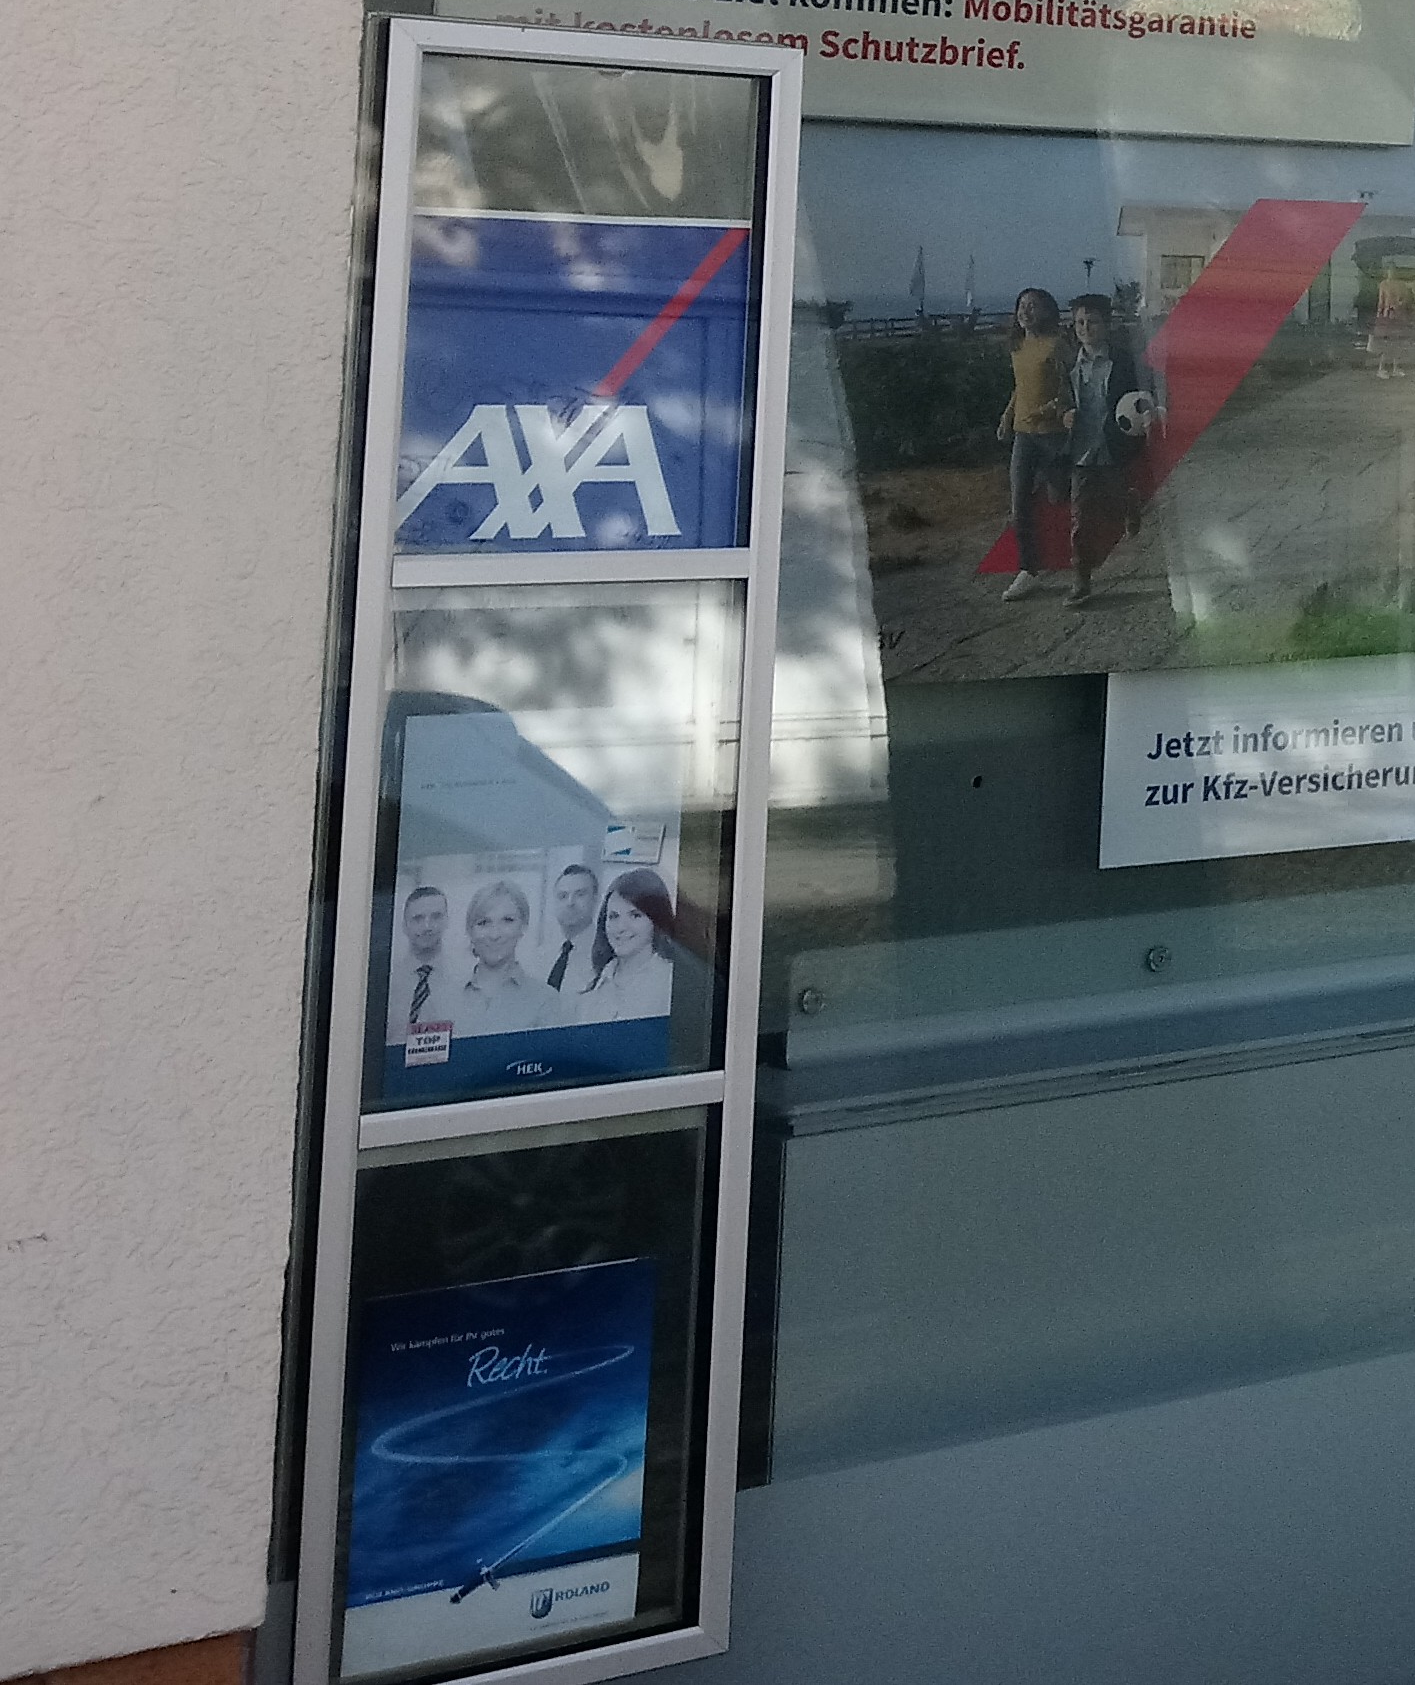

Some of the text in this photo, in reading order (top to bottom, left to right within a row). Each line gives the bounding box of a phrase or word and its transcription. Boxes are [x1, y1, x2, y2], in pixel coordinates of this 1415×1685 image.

[820, 30, 1025, 71] Schutzbrief.
[395, 404, 682, 540] AXA
[1146, 730, 1224, 760] Jetzt
[1232, 720, 1404, 755] informieren
[1144, 778, 1195, 807] zur
[466, 1343, 549, 1388] Recht.
[554, 1580, 611, 1602] ROLAND
